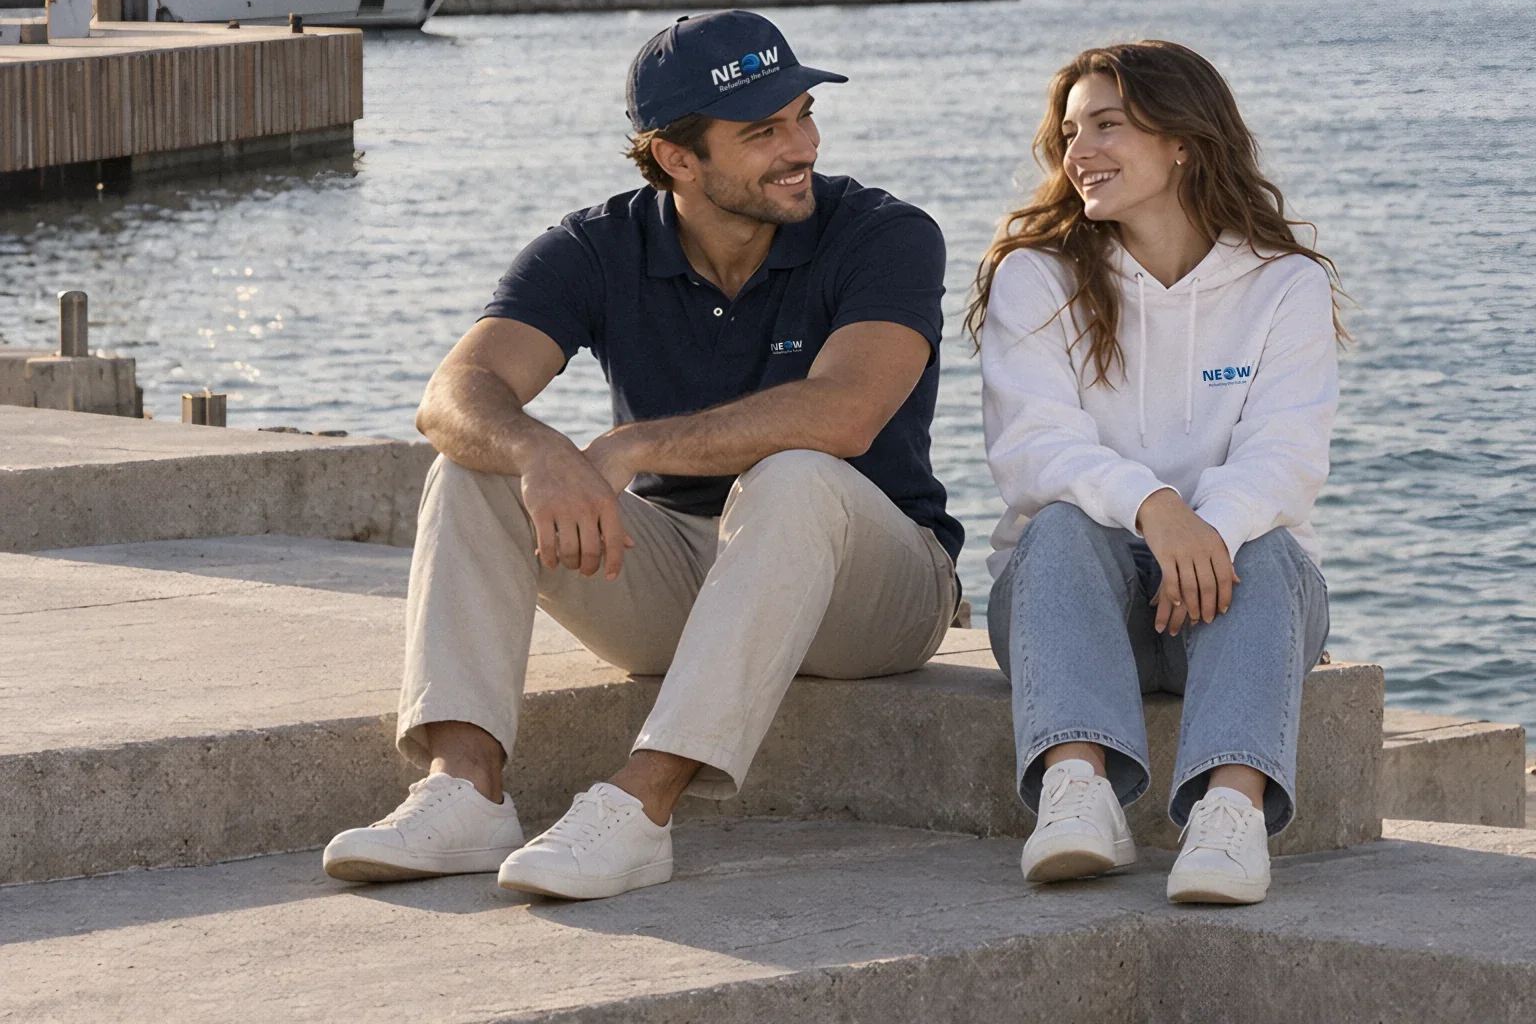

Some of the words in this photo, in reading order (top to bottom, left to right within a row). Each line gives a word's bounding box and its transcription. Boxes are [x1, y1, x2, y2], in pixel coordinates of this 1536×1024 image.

[719, 77, 751, 92] Refueling
[750, 73, 761, 81] the
[761, 66, 780, 76] Future
